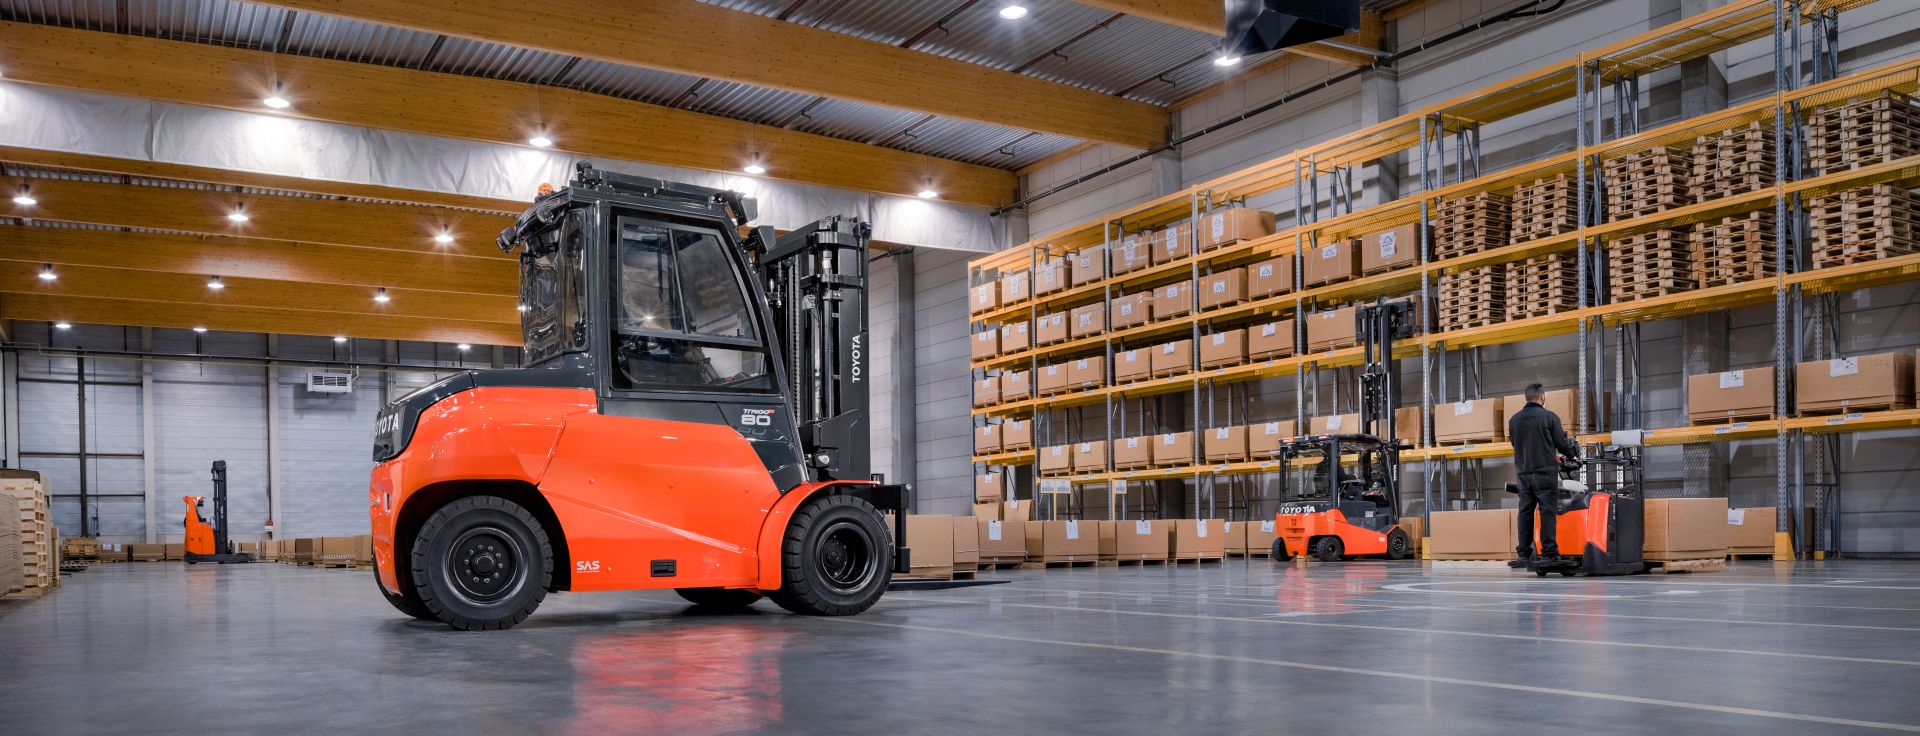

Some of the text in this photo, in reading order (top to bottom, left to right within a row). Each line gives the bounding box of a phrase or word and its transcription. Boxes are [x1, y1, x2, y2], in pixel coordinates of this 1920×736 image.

[852, 334, 860, 383] TOYOTA
[741, 414, 770, 426] 80
[576, 560, 600, 571] SAS
